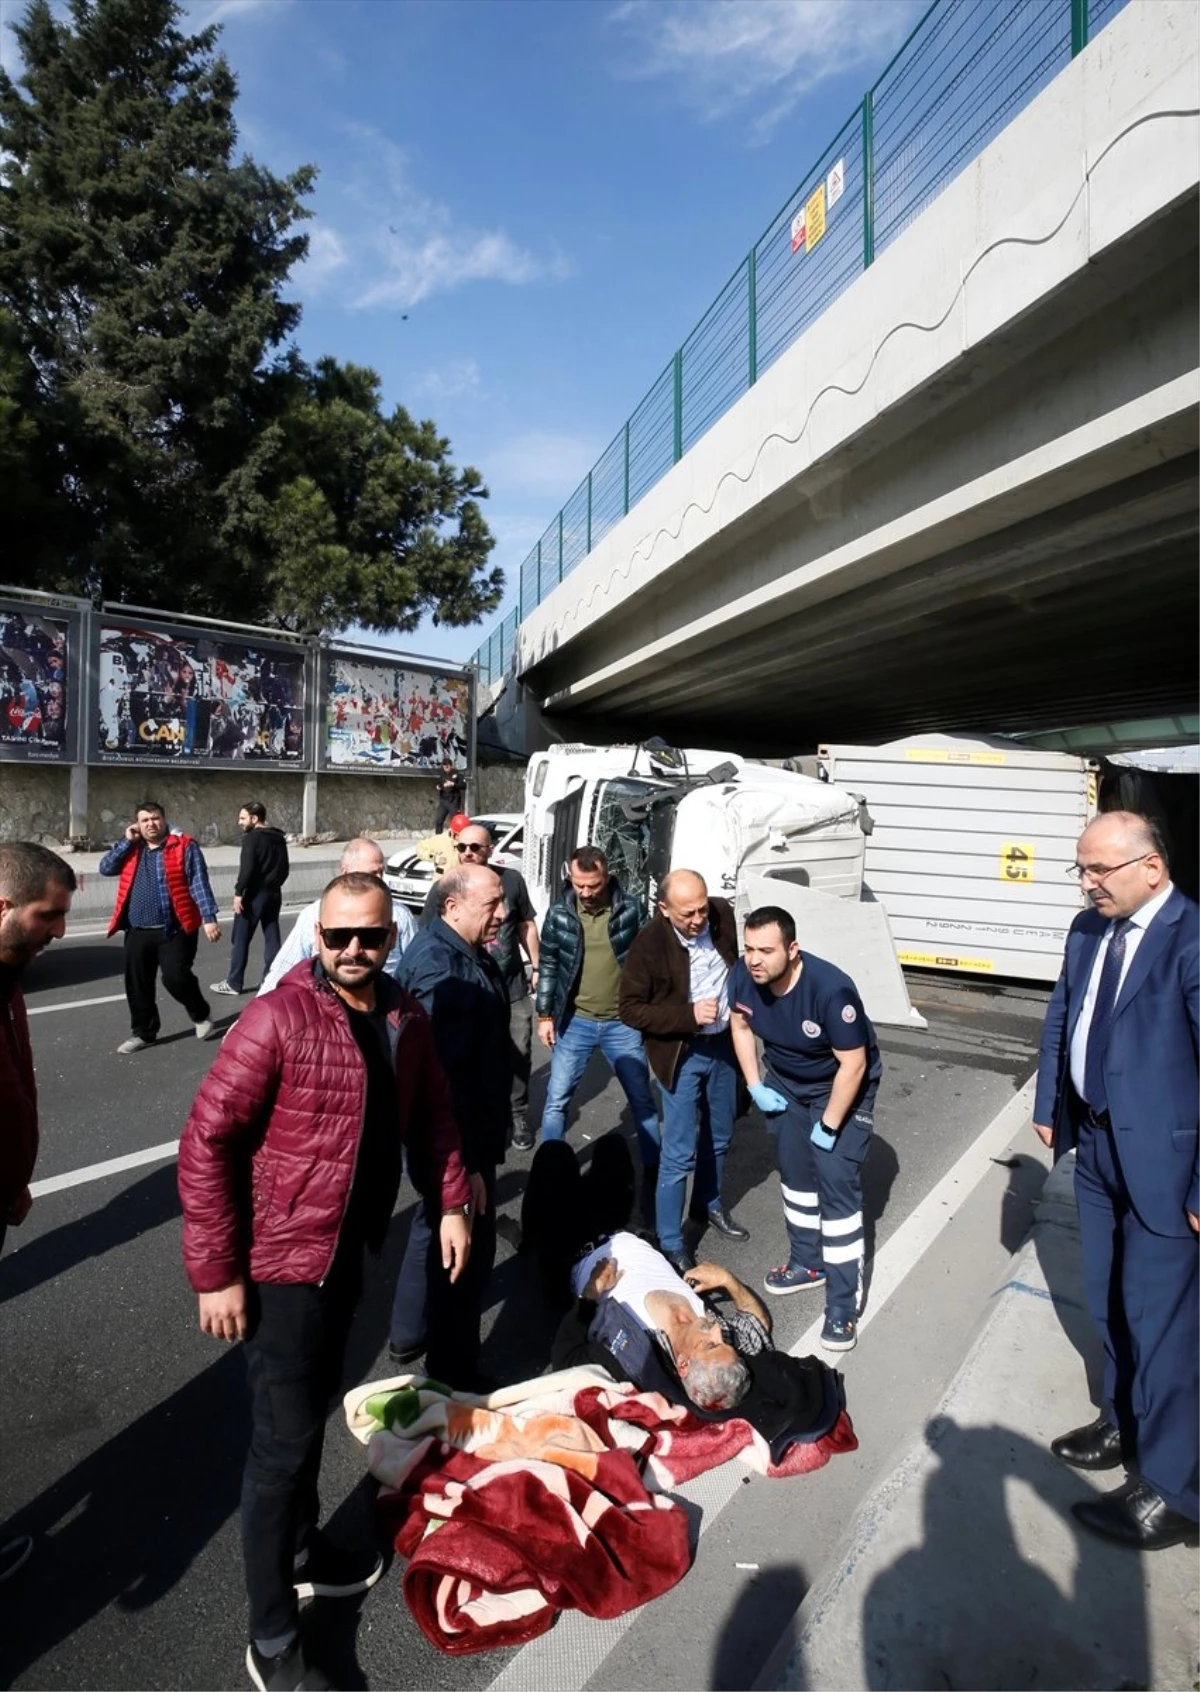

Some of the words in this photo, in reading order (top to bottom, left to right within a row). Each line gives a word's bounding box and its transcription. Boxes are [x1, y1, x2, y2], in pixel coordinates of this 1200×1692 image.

[1006, 846, 1029, 879] 45
[720, 873, 738, 890] 34
[1012, 928, 1065, 940] MAEU
